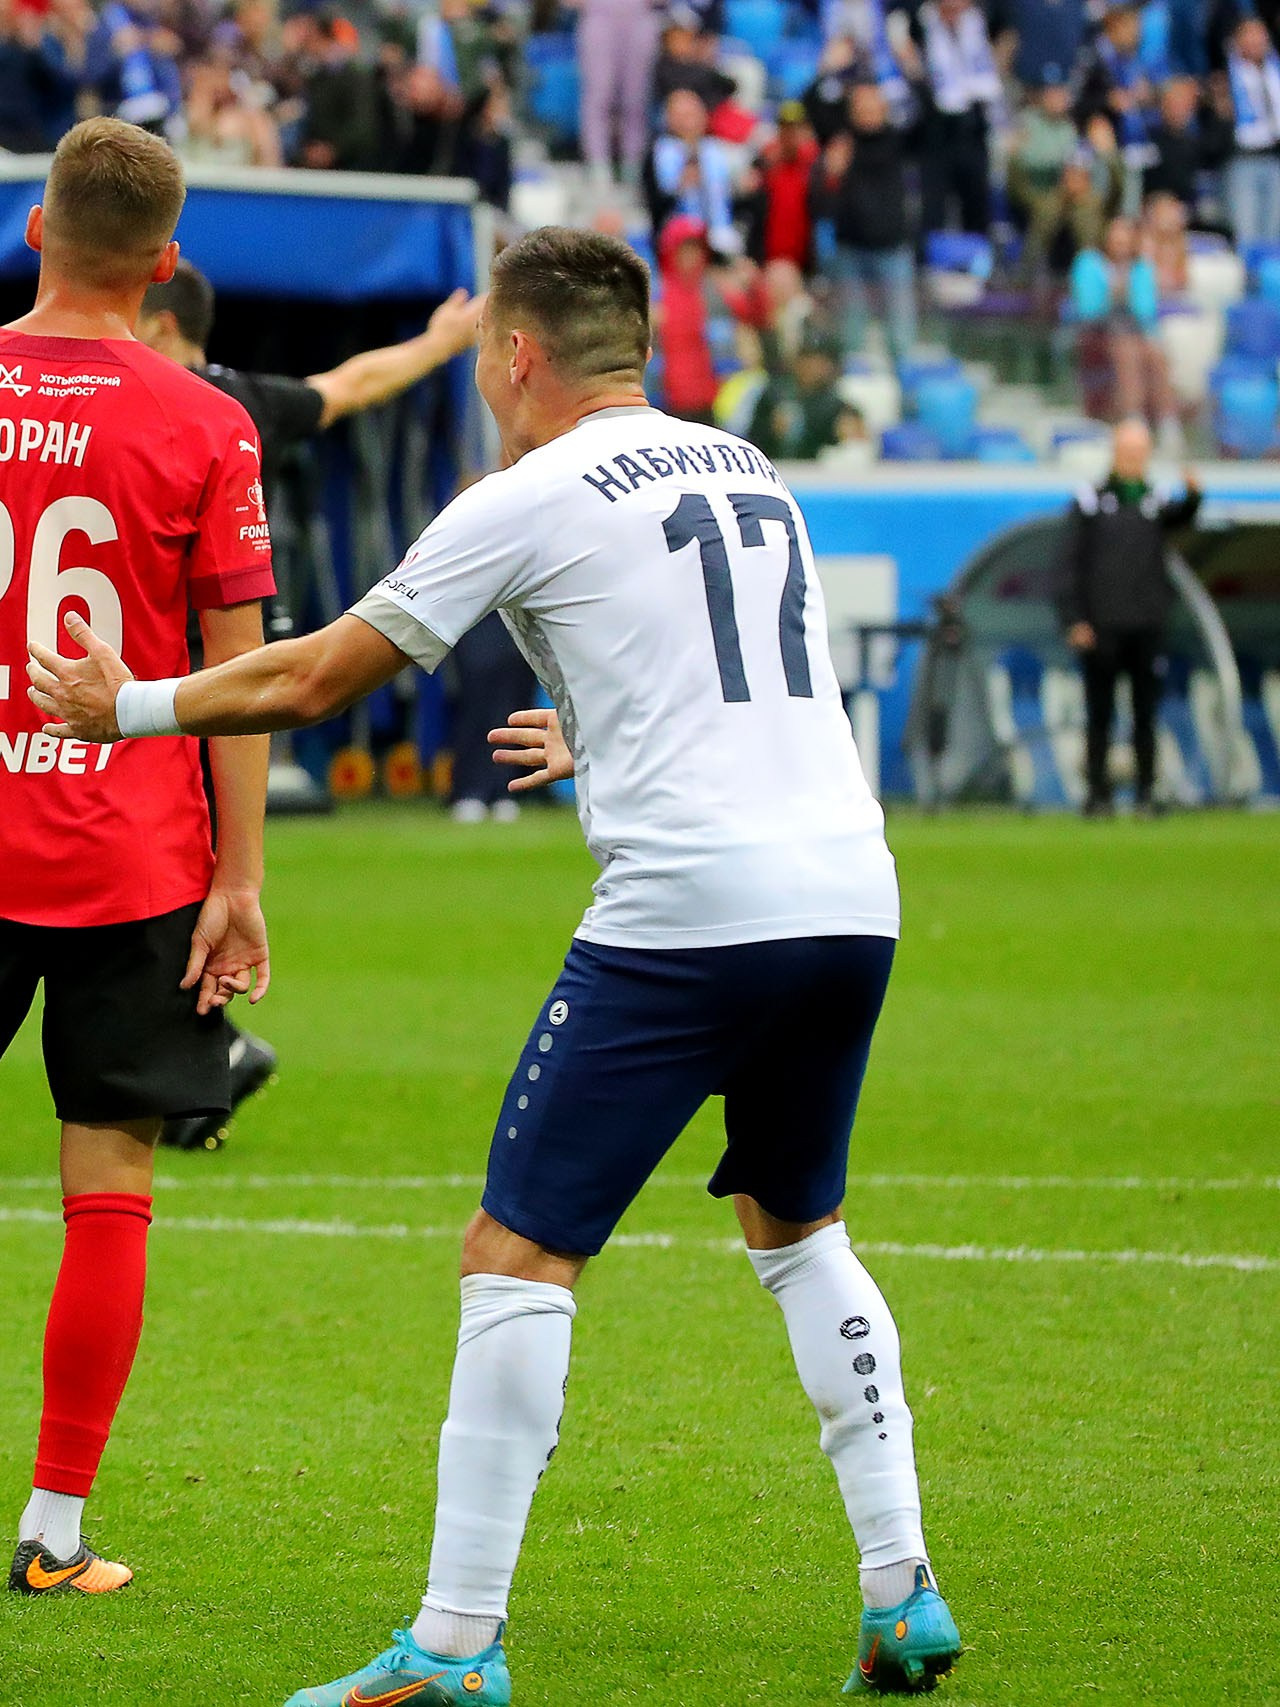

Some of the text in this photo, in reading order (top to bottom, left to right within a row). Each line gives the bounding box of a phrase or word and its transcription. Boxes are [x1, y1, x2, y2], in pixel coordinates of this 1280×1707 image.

[39, 373, 121, 387] ХОТЬКОВСКИЙ
[37, 385, 97, 398] АВТОМОСТ
[661, 493, 814, 703] 17
